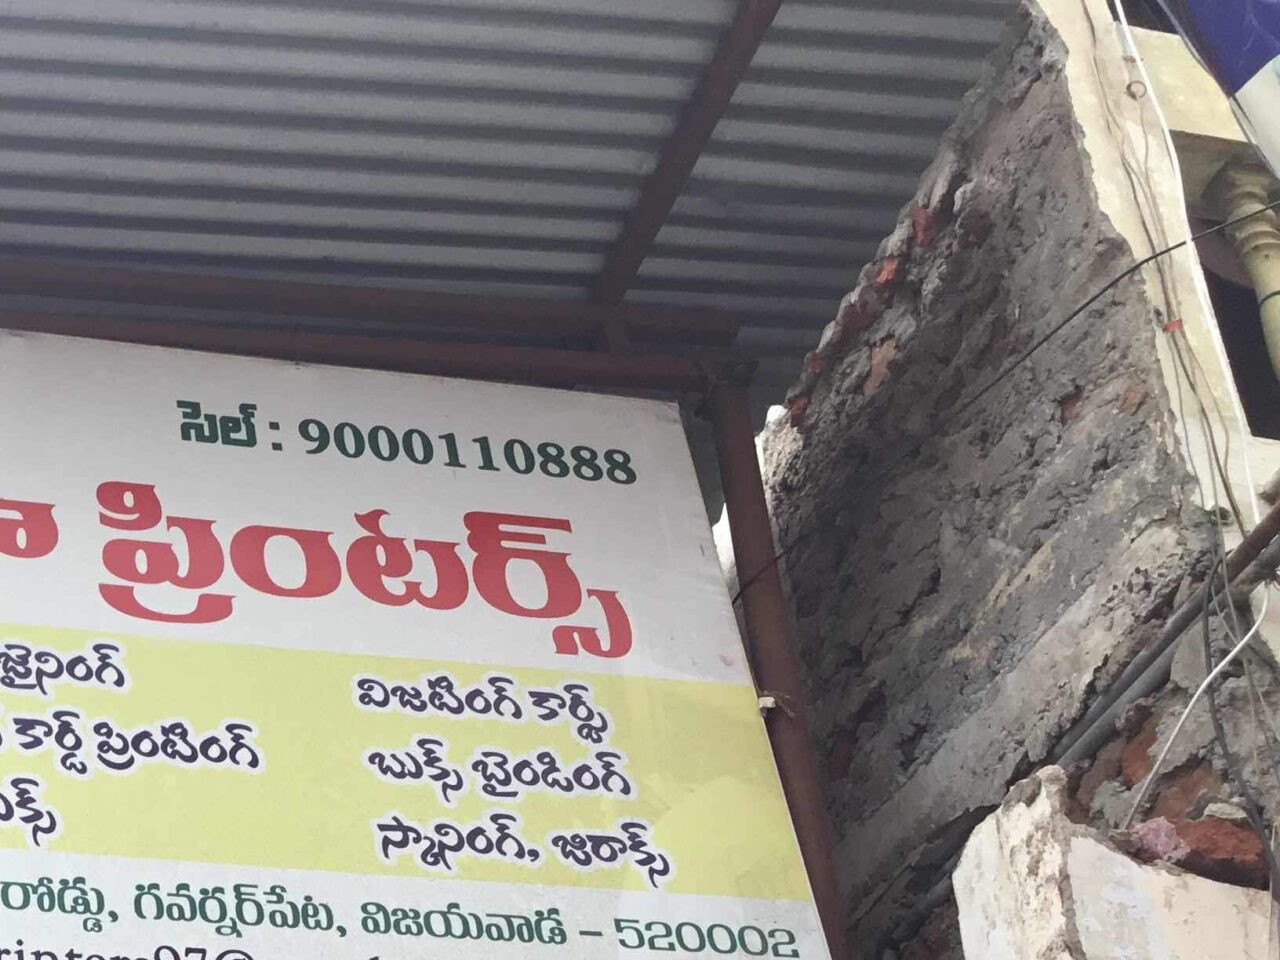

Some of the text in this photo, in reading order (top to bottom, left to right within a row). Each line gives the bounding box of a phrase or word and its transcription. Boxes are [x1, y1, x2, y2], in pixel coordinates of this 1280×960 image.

[175, 399, 258, 448] సెల్
[297, 418, 638, 486] 9000110888
[97, 482, 632, 657] ప్రింటర్స్
[12, 710, 88, 775] కార్డ్
[93, 722, 259, 771] ప్రింటింగ్
[368, 738, 631, 803] బుక్స్ బైండింగ్
[551, 822, 670, 888] జిరాక్స్
[0, 876, 119, 933] రోడ్డు,
[360, 902, 568, 945] విజయవాడ
[613, 918, 800, 959] 520002
